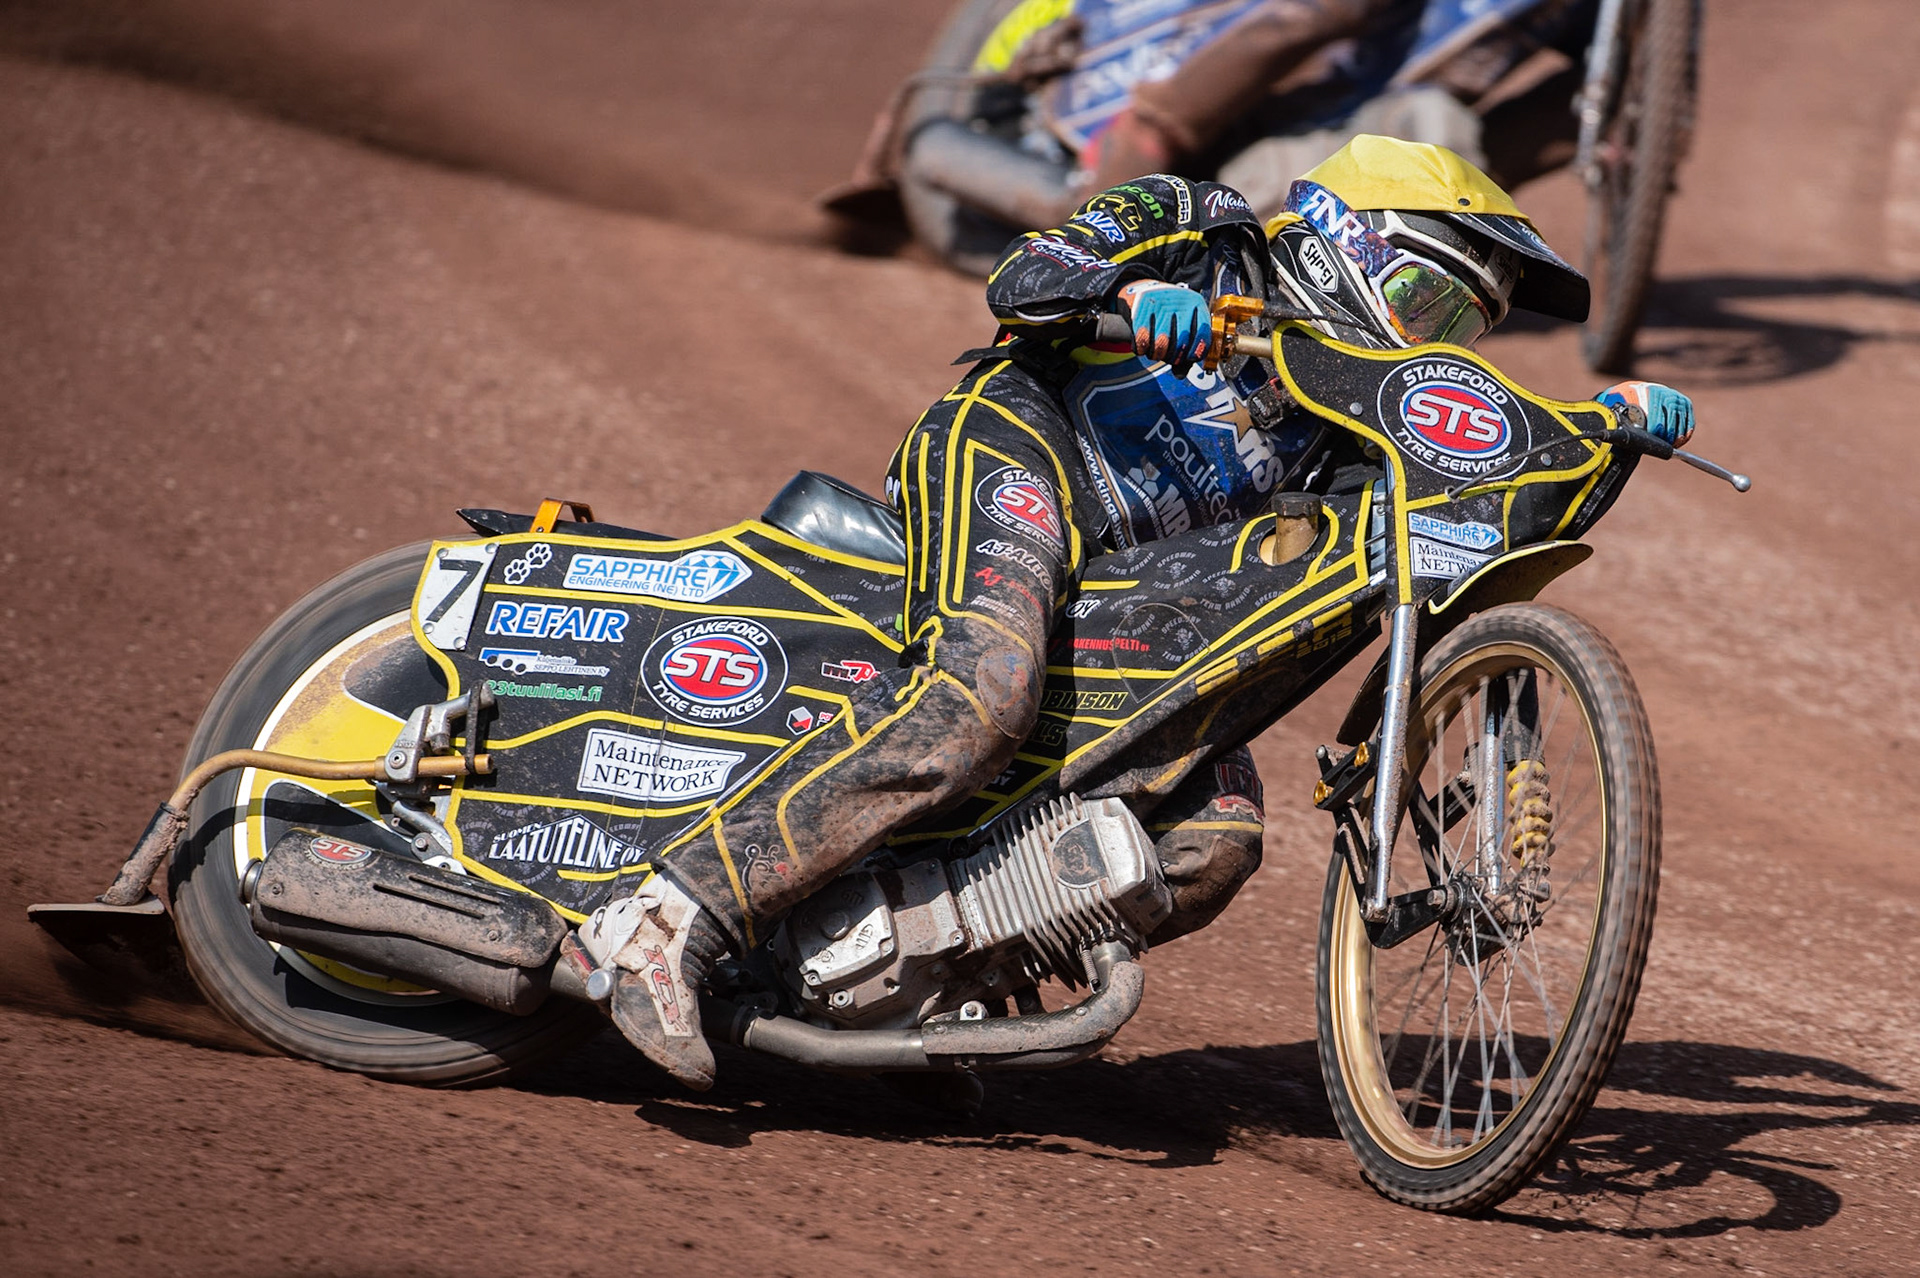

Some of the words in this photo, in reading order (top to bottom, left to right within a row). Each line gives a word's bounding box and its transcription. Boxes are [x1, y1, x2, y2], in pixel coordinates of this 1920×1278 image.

[1403, 364, 1508, 406] STAKEFORD
[1405, 391, 1503, 444] STS
[1396, 427, 1434, 461] TYRE
[1144, 413, 1233, 525] poultec
[985, 503, 1015, 525] TYRE
[996, 486, 1061, 539] STS
[1411, 515, 1478, 541] SAPPHIRE
[568, 575, 650, 591] ENGINEERING
[652, 582, 678, 596] (NE)
[681, 587, 704, 598] LTD
[572, 557, 708, 589] SAPPHIRE
[425, 558, 485, 623] 7
[486, 602, 628, 642] REFAIR
[671, 620, 769, 647] STAKEFORD
[558, 665, 597, 675] LEHTINEN
[664, 646, 760, 688] STS
[653, 680, 688, 713] TYRE
[688, 693, 764, 720] SERVICES
[594, 740, 729, 771] Maintenance
[592, 764, 718, 793] NETWORK
[312, 839, 366, 858] STS
[488, 817, 623, 869] LAATUTELINE
